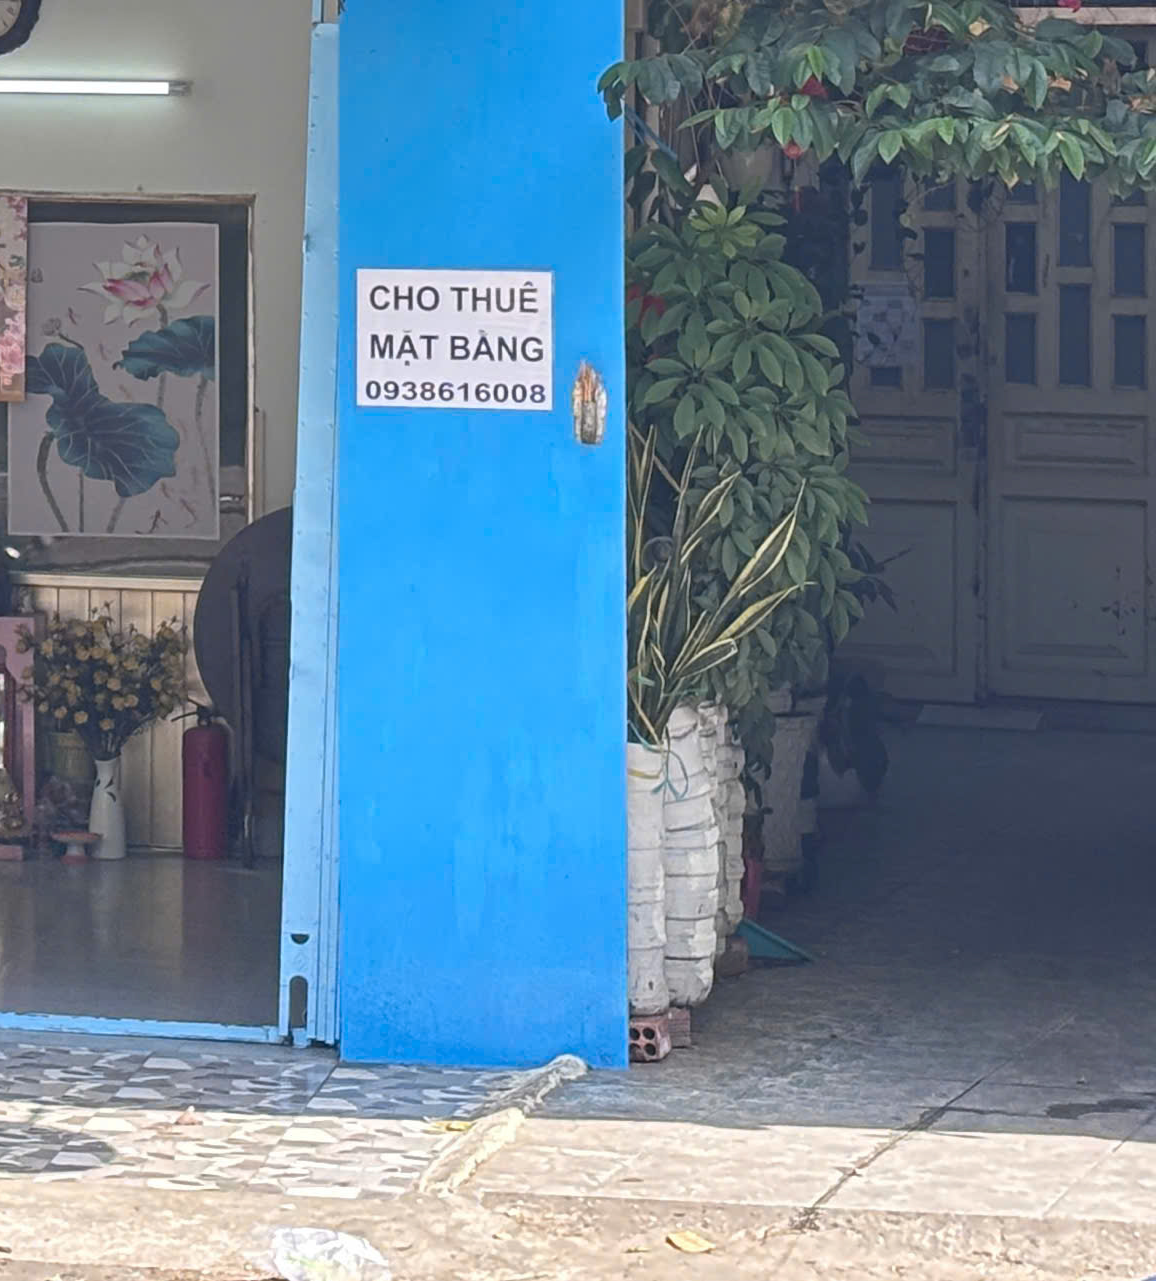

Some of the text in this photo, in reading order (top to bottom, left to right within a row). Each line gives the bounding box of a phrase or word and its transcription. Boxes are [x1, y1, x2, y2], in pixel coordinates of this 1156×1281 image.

[369, 281, 539, 314] CHO THUÊ
[369, 329, 545, 366] MẶT BẰNG
[365, 380, 547, 404] 0938616008
